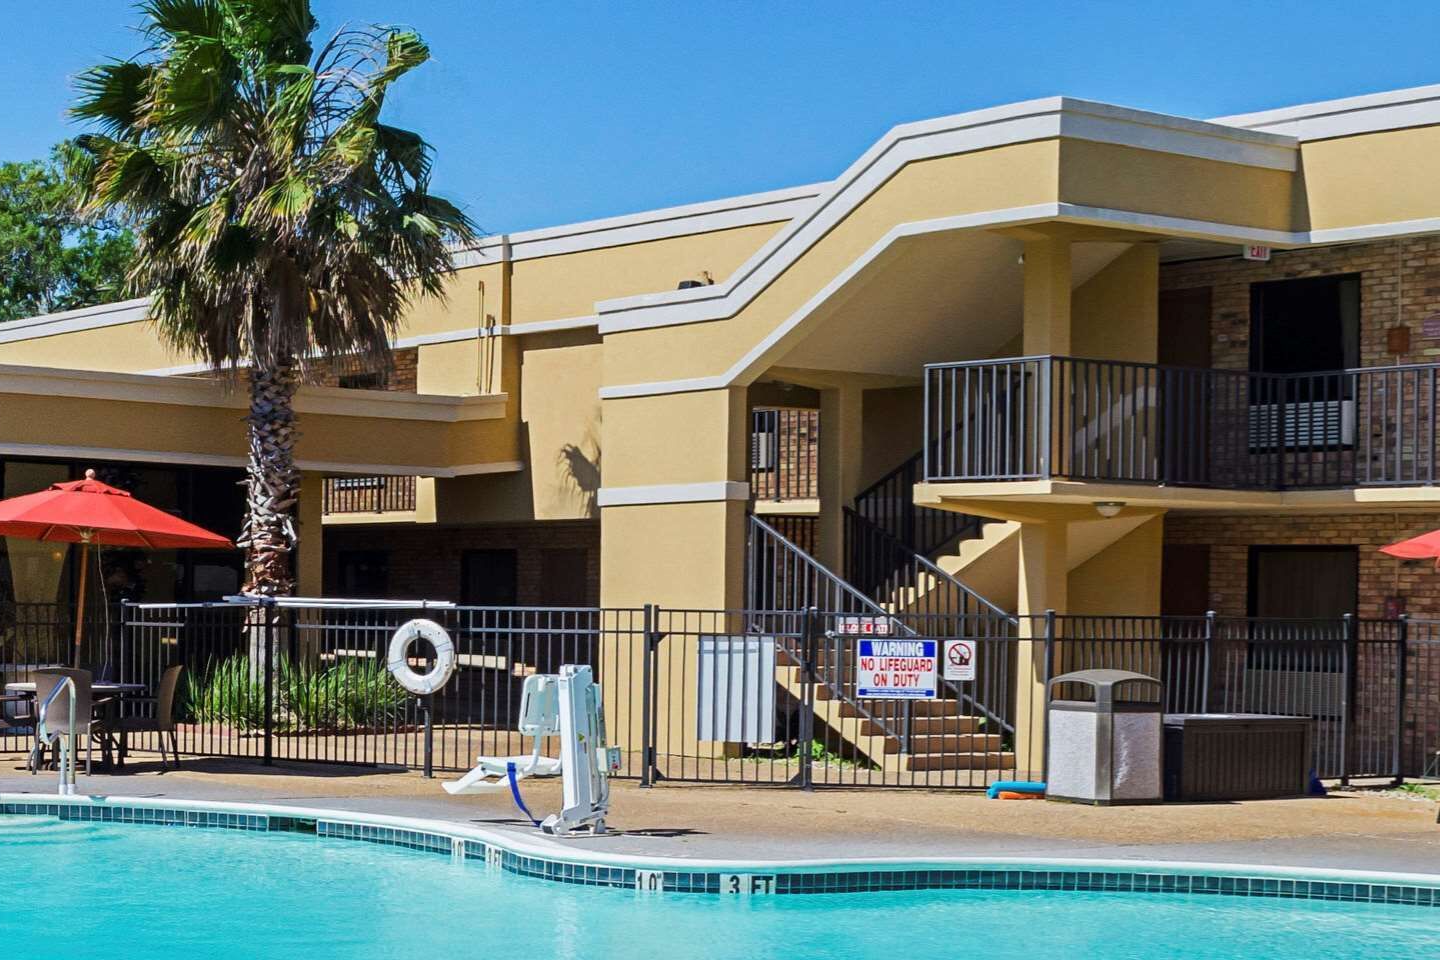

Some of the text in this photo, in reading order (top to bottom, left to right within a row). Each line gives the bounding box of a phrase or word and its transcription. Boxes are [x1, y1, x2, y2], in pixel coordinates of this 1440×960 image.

[871, 641, 924, 656] WARNING
[861, 658, 932, 671] NO LIFEGUARD
[873, 674, 920, 687] ON DUTY
[729, 875, 740, 894] 3
[751, 875, 774, 894] FT
